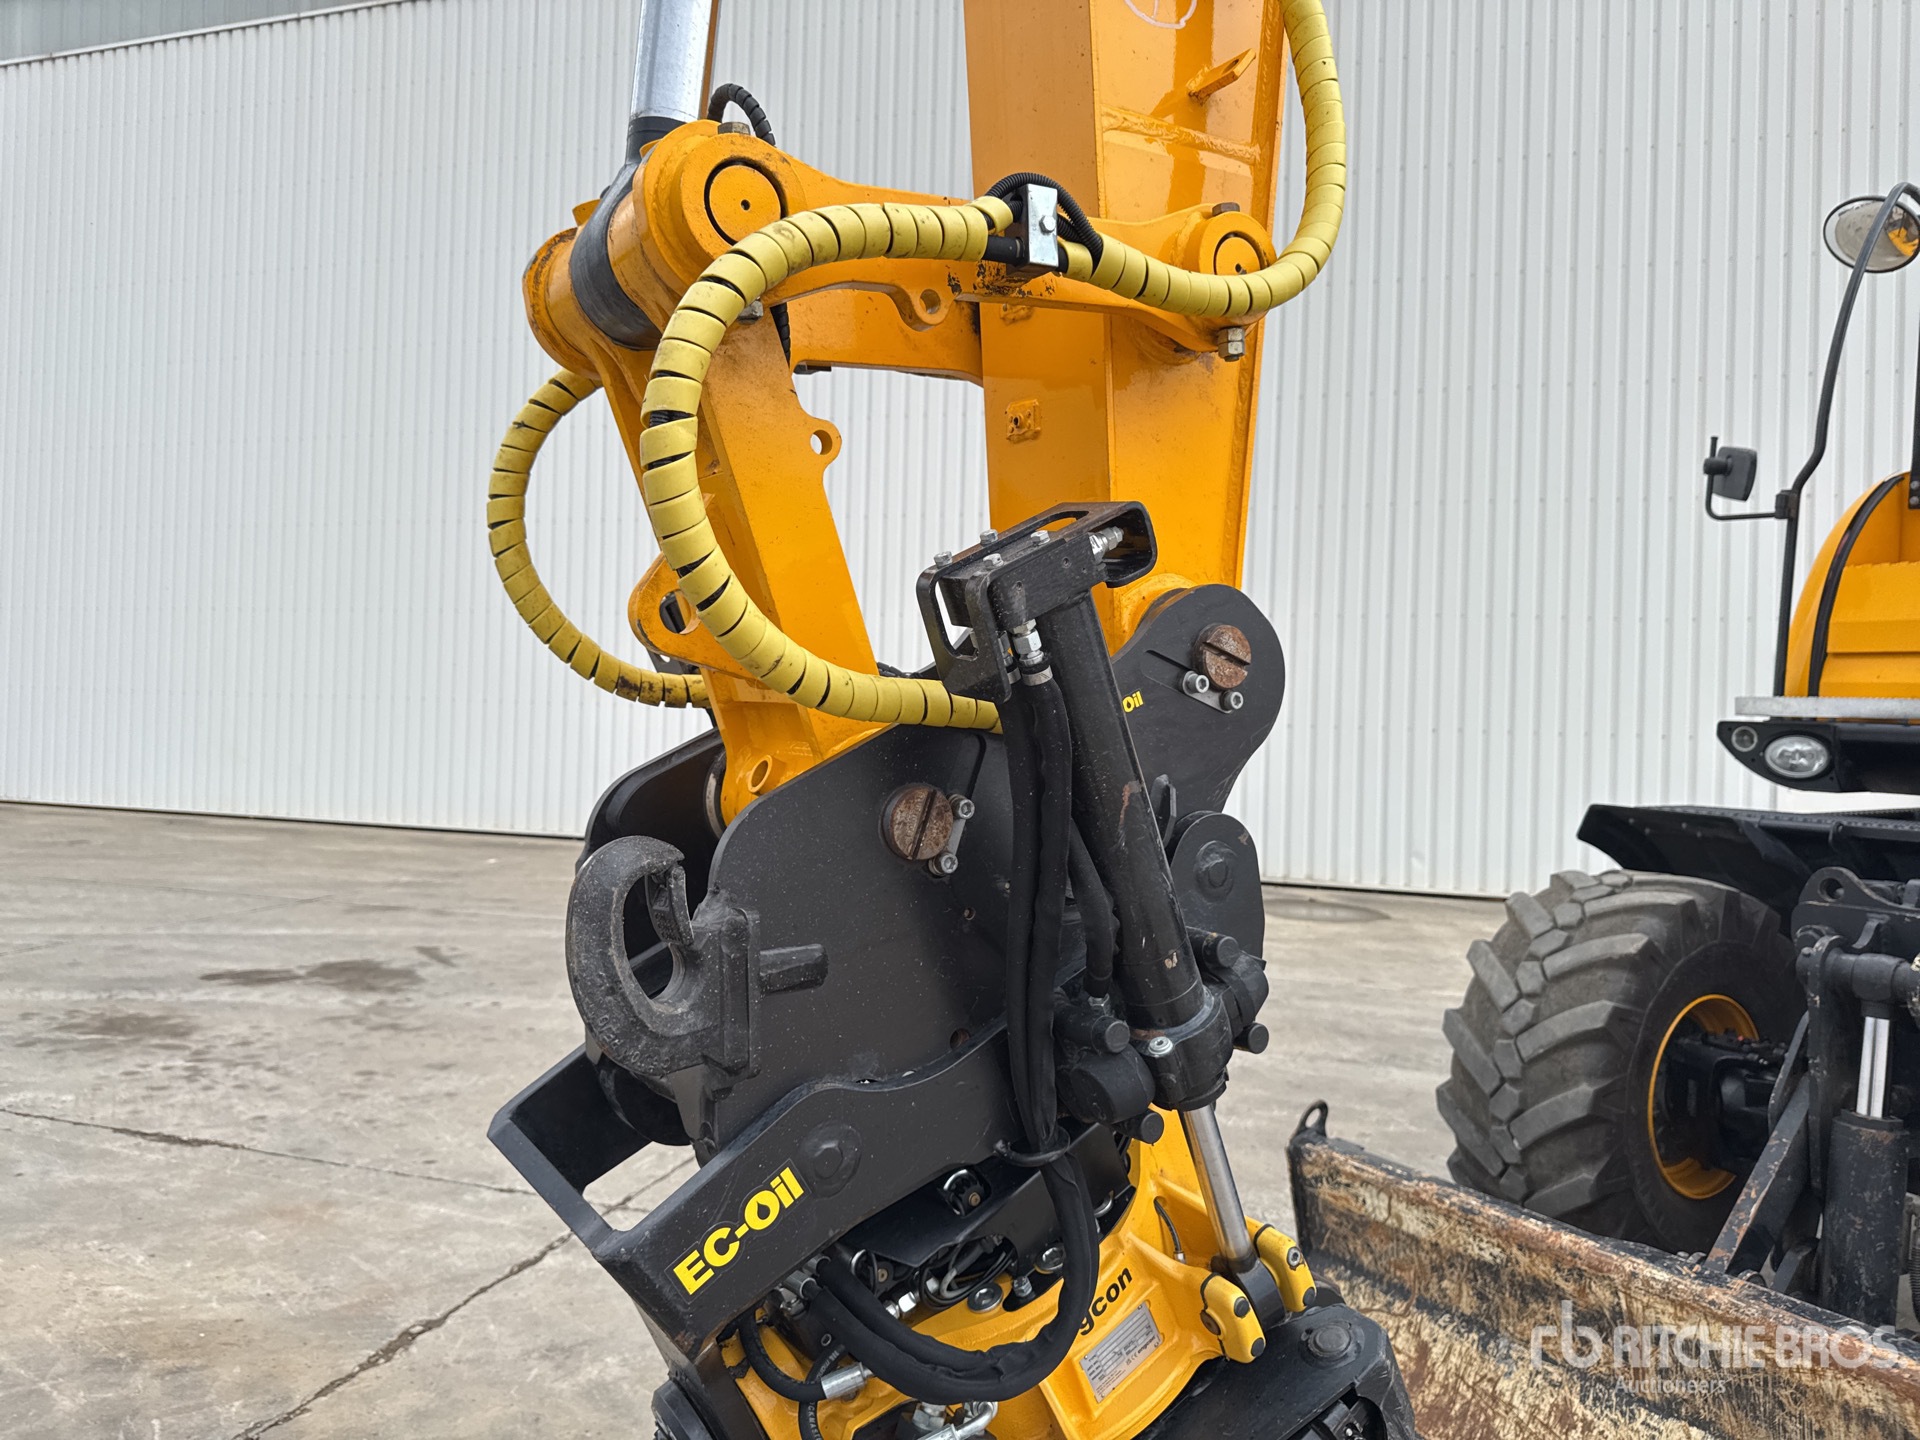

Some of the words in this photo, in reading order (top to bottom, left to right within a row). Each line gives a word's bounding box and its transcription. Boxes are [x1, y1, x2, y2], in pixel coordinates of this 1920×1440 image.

[1122, 690, 1144, 713] Oil
[673, 1167, 805, 1295] EC-Oil
[1079, 1267, 1133, 1336] gcon
